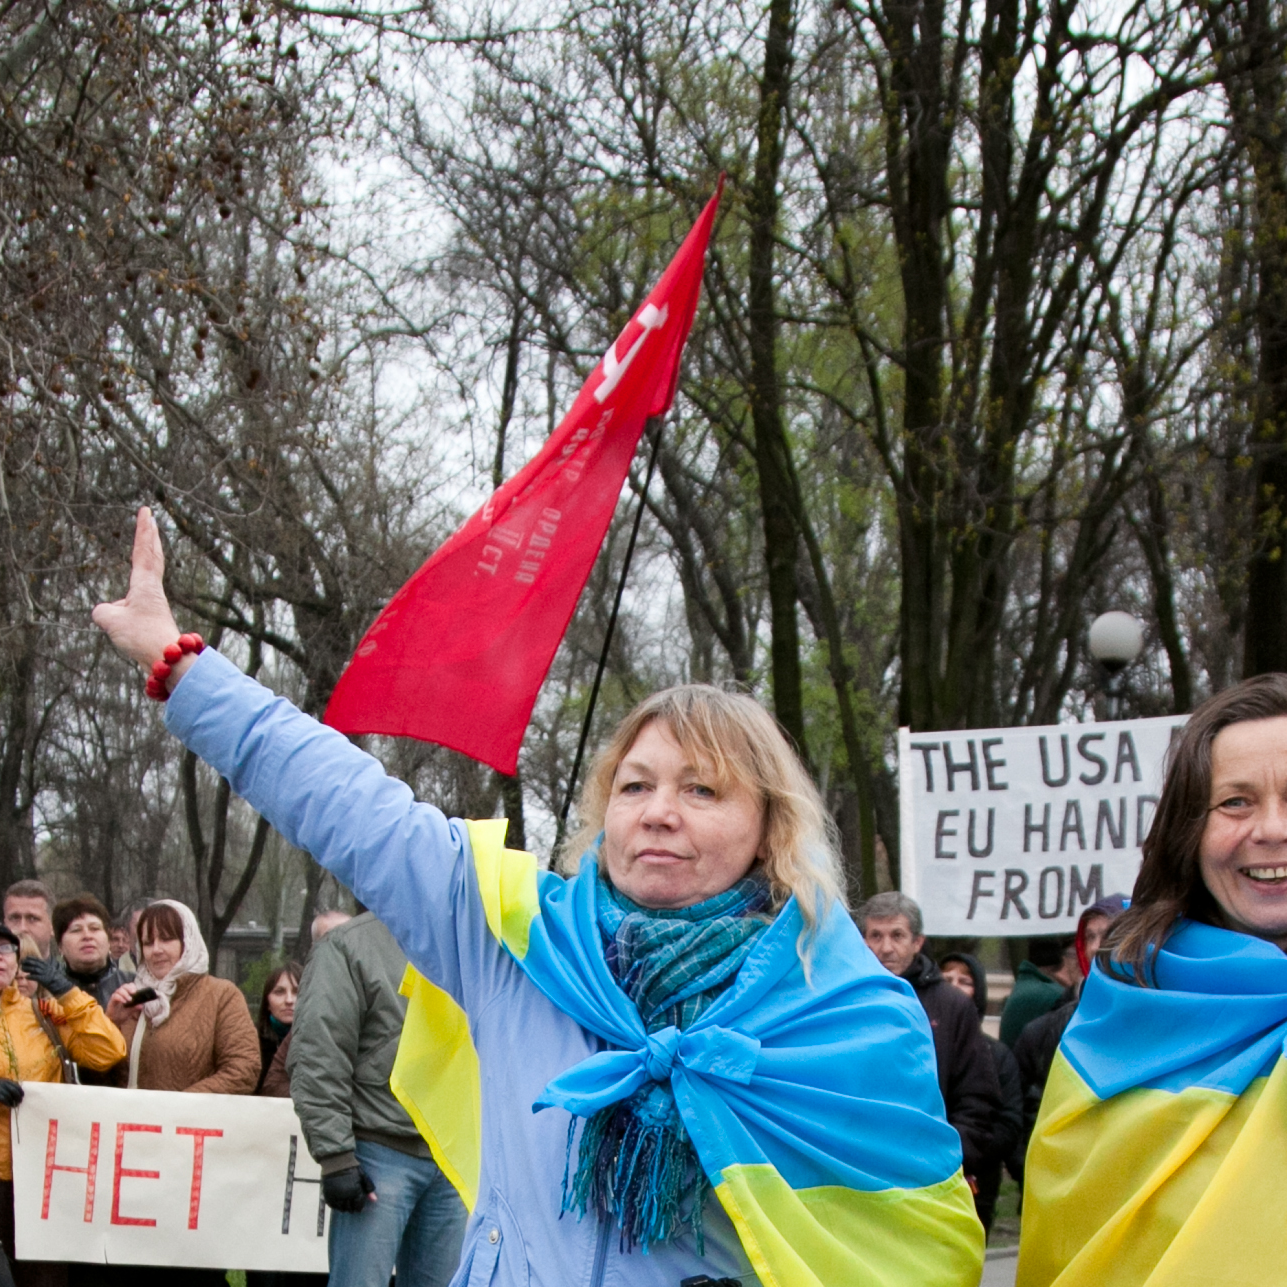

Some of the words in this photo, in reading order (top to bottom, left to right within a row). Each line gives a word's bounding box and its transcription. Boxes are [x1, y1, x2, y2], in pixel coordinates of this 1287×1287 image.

[514, 506, 562, 584] ОРДЕНА
[910, 737, 1009, 792] THE
[1038, 731, 1143, 788] USA
[934, 807, 995, 860] EU
[966, 864, 1104, 921] FROM
[40, 1118, 224, 1231] НЕТ
